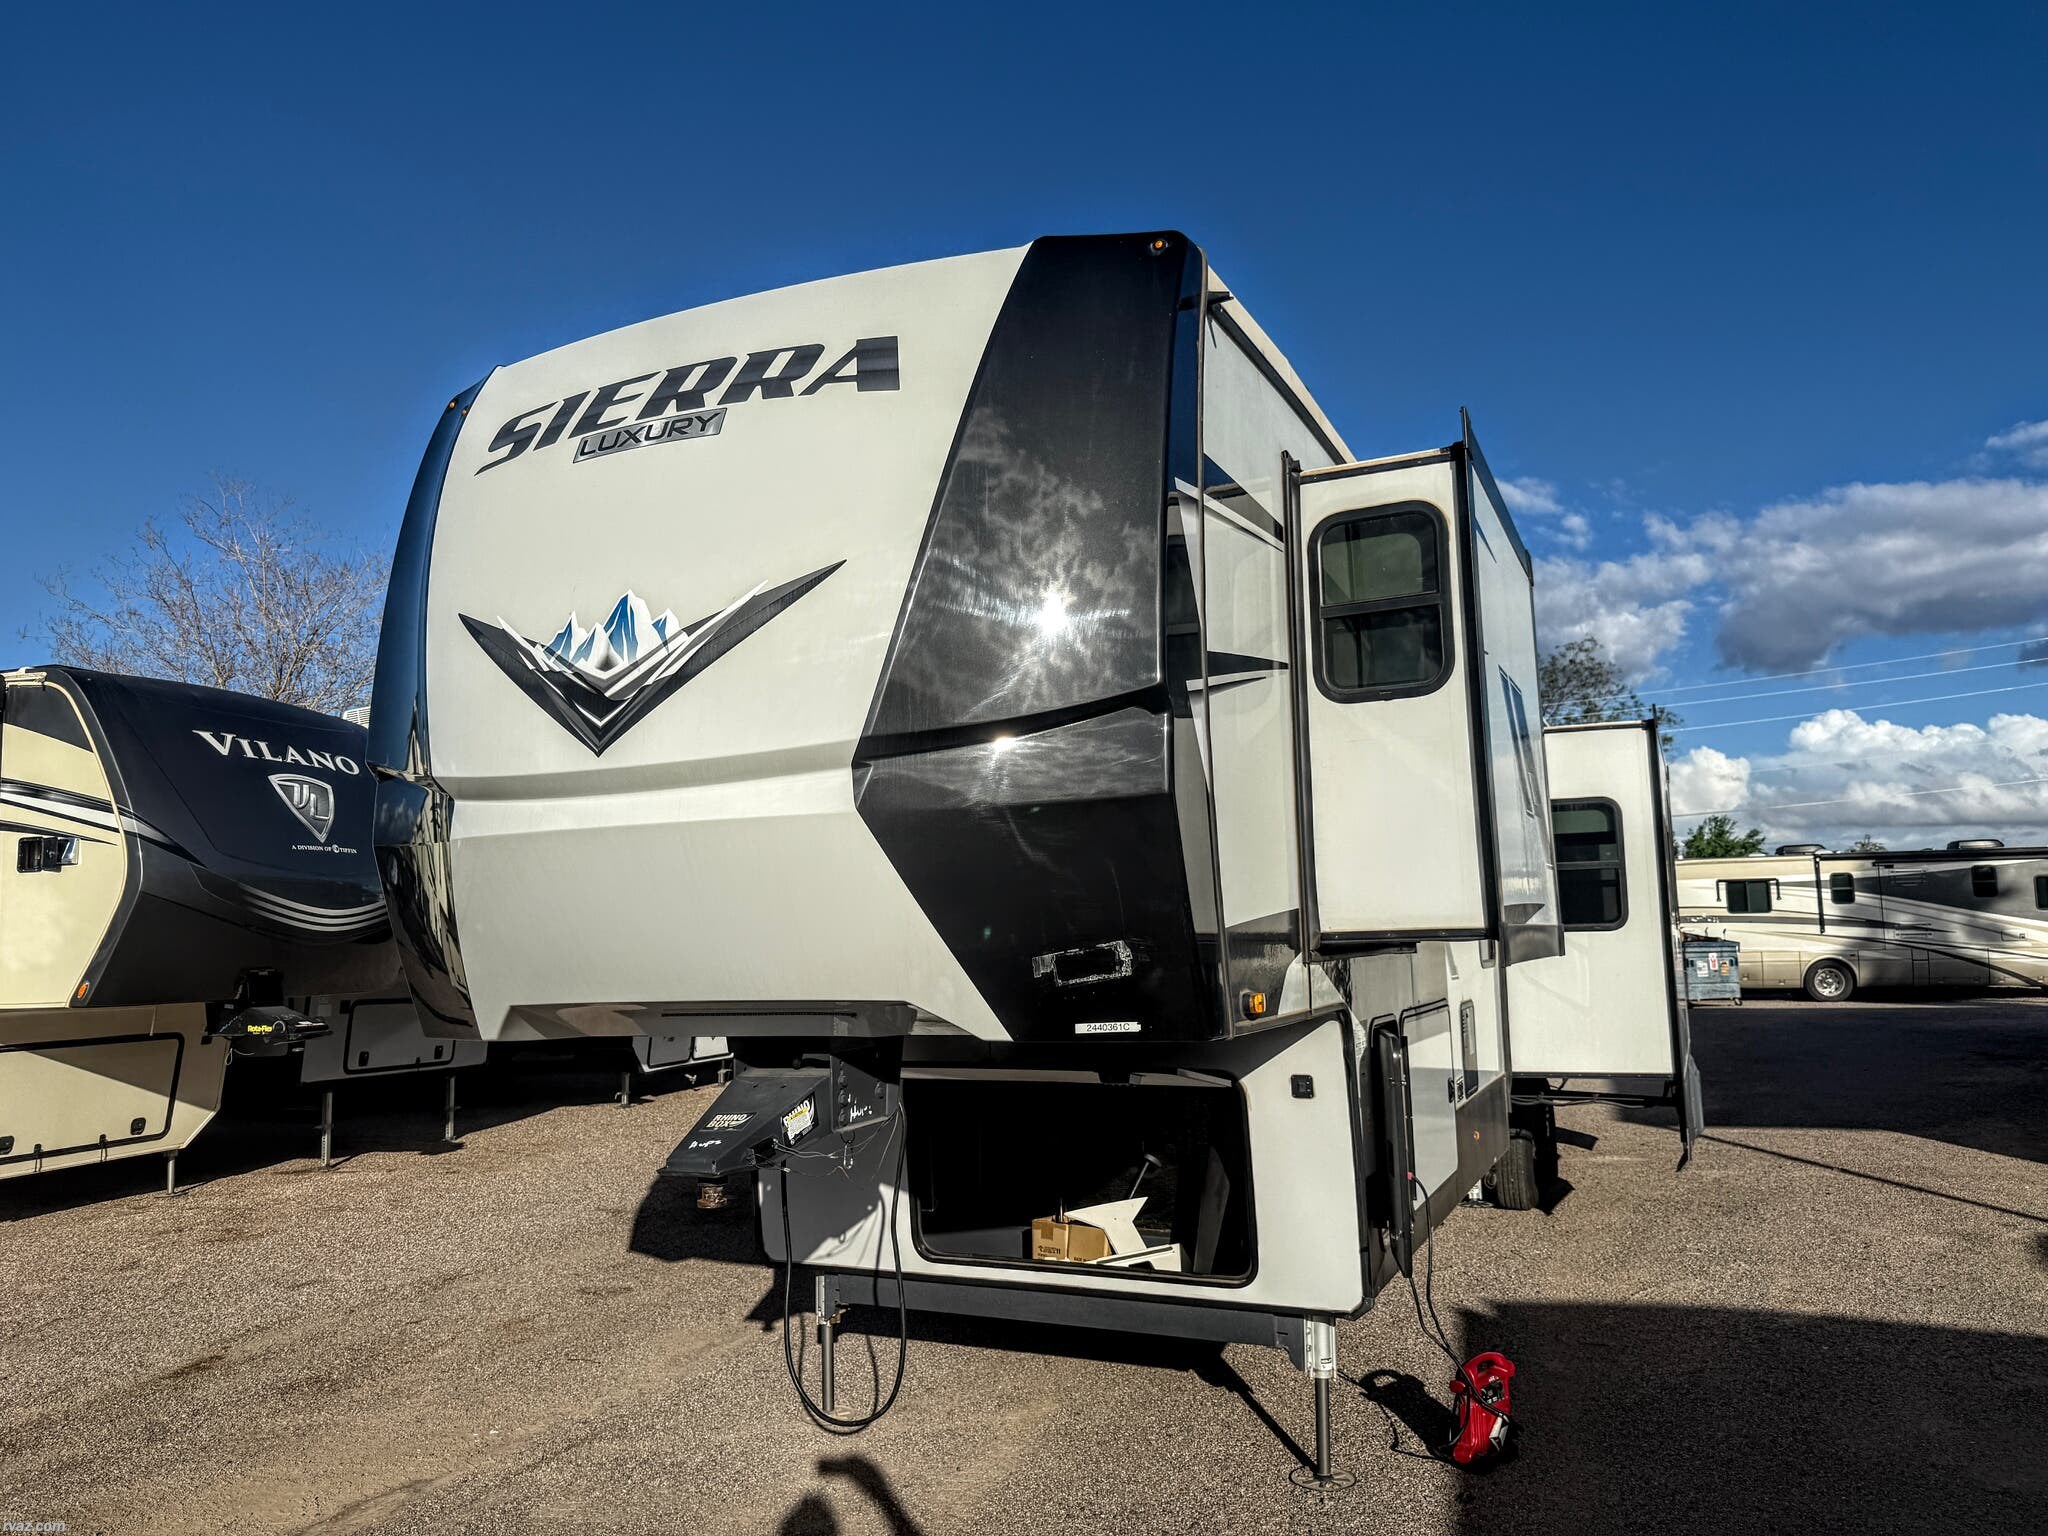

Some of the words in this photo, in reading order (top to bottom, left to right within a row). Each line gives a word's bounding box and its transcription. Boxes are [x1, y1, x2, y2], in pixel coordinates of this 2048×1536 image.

[474, 336, 901, 477] SIERRA
[579, 412, 721, 457] LUXURY
[192, 729, 360, 776] VILANO
[297, 844, 324, 852] DIVISION
[1086, 1022, 1130, 1032] 2440361C
[712, 1113, 748, 1121] RHINO
[706, 1120, 731, 1128] BOX
